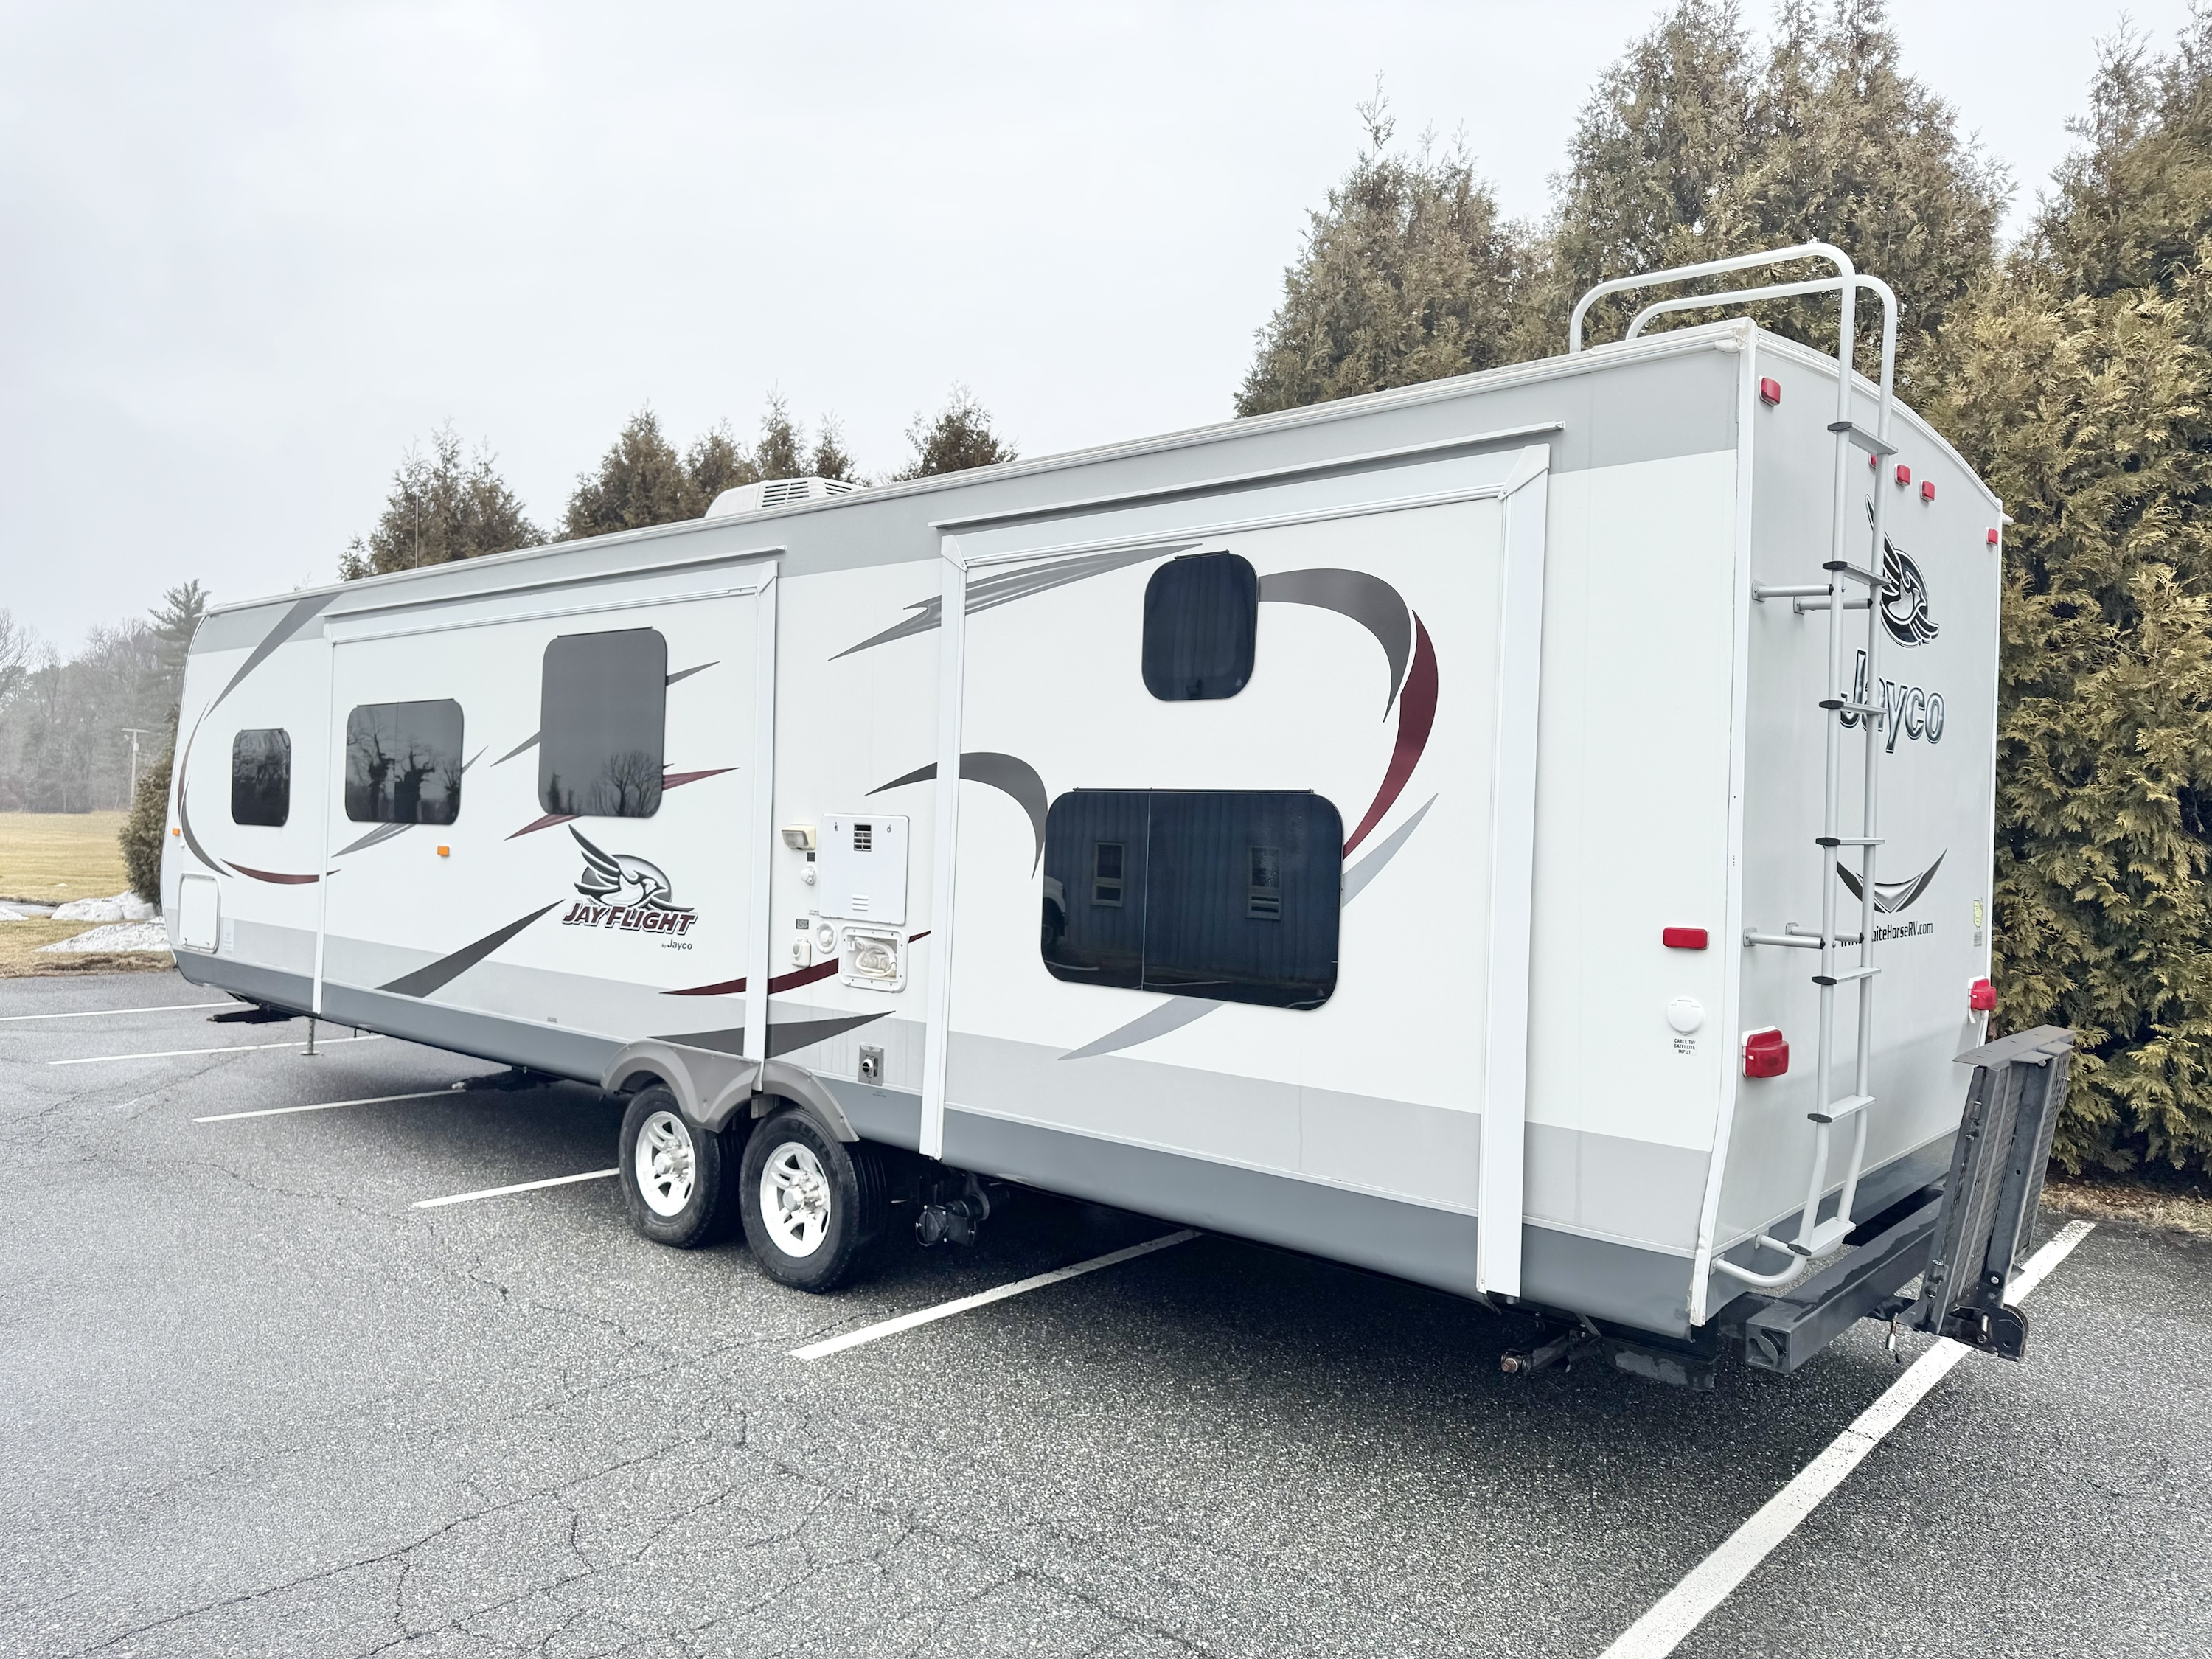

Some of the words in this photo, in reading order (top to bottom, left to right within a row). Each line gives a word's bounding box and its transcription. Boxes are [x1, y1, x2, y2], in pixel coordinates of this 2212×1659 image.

[562, 901, 606, 926] JAY
[605, 904, 698, 935] FLIGHT
[667, 939, 693, 951] Jayco
